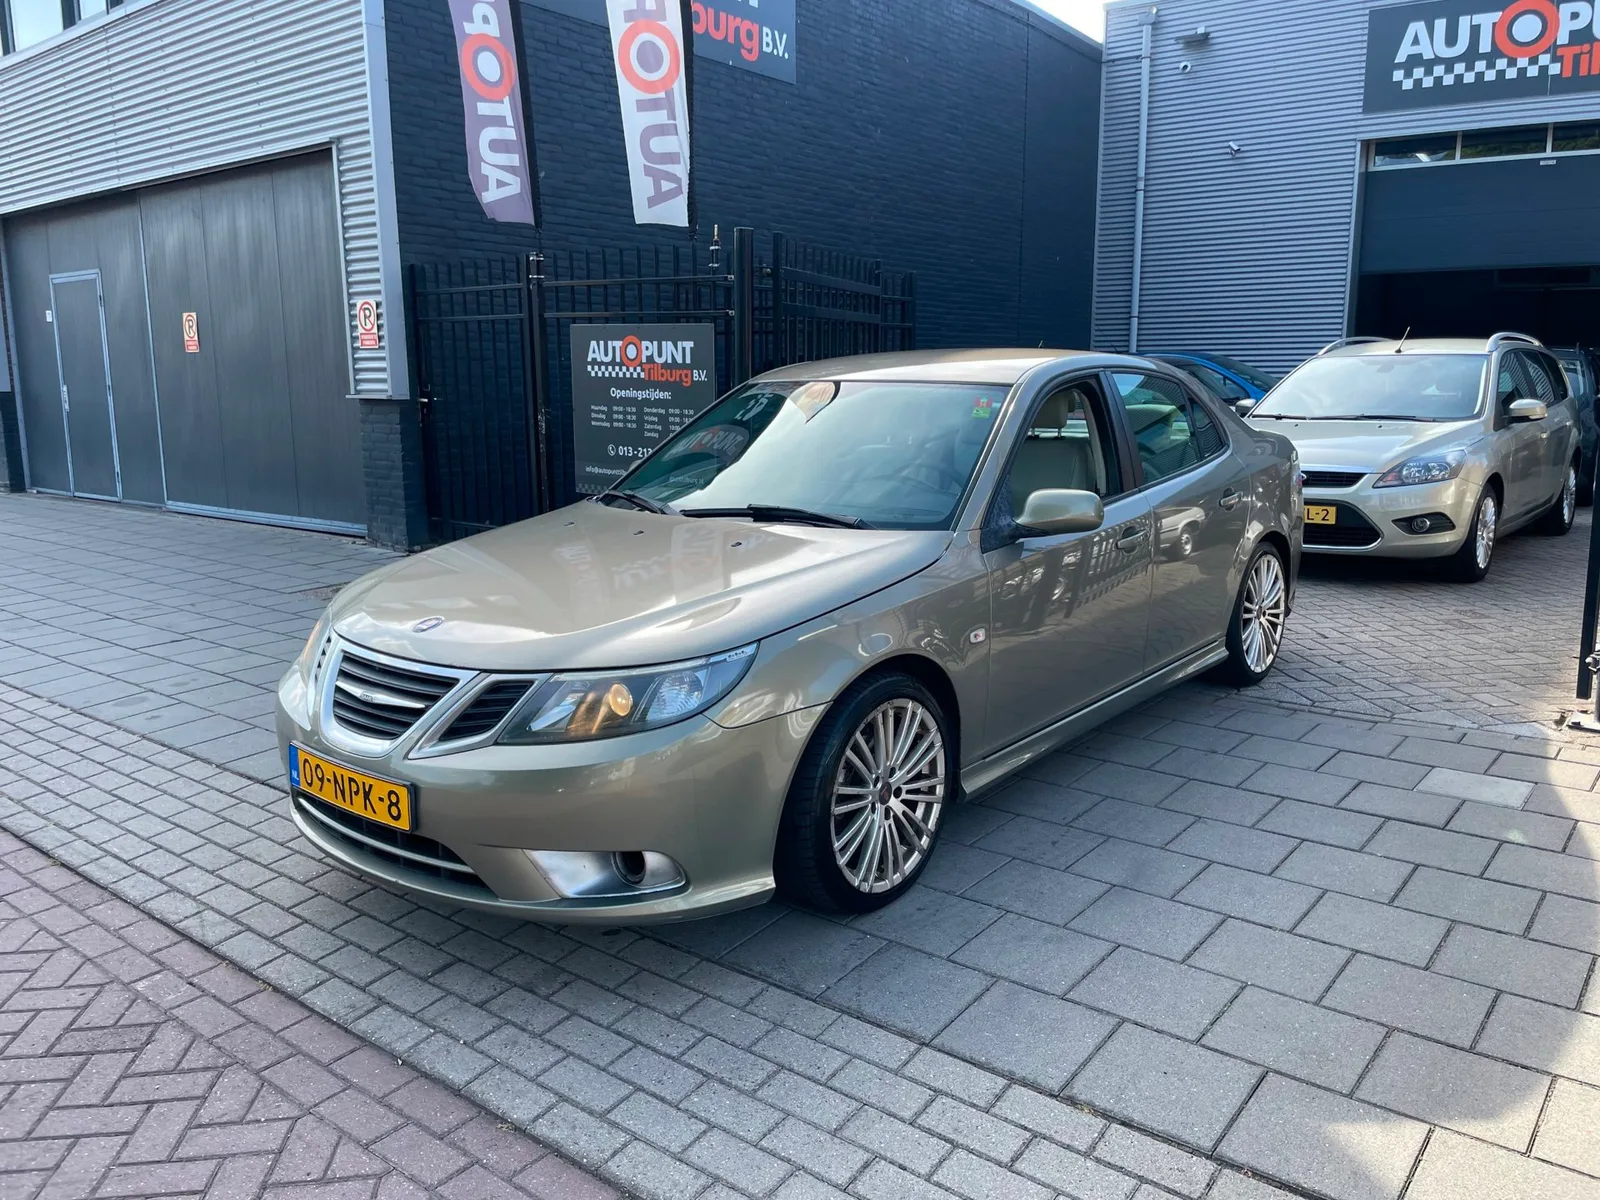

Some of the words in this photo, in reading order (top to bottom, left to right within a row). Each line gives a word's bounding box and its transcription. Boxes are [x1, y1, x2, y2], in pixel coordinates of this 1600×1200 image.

[762, 26, 789, 60] B.V.
[1394, 0, 1600, 63] AUTOP
[587, 335, 694, 367] AUTOPUNT
[642, 363, 692, 387] Tilburg
[693, 370, 707, 381] B.V.
[610, 387, 671, 400] Openingstijden:
[1305, 508, 1330, 521] L-2
[303, 757, 401, 821] 09-NPK-8
